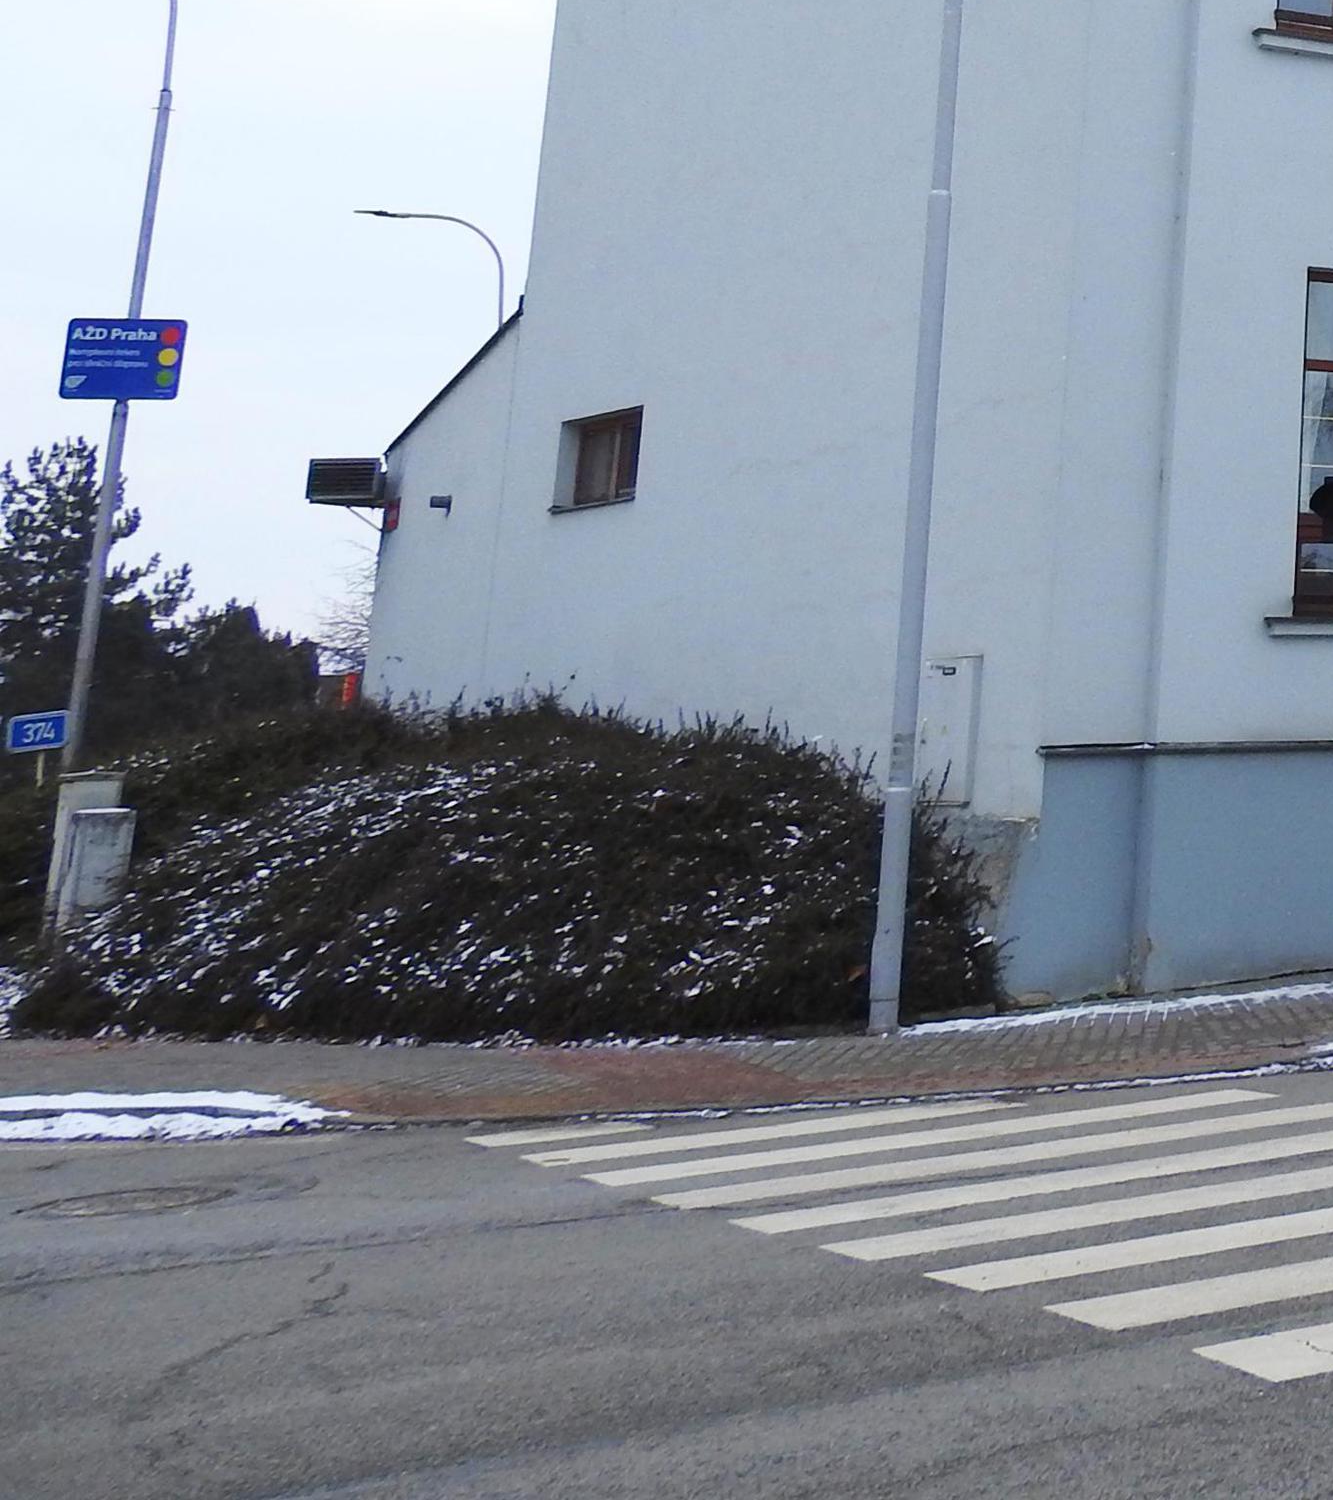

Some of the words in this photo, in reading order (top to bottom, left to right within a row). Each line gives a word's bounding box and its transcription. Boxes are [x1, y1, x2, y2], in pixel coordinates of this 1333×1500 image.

[72, 325, 108, 340] AŽD
[111, 327, 158, 341] Praha
[22, 722, 55, 743] 374
